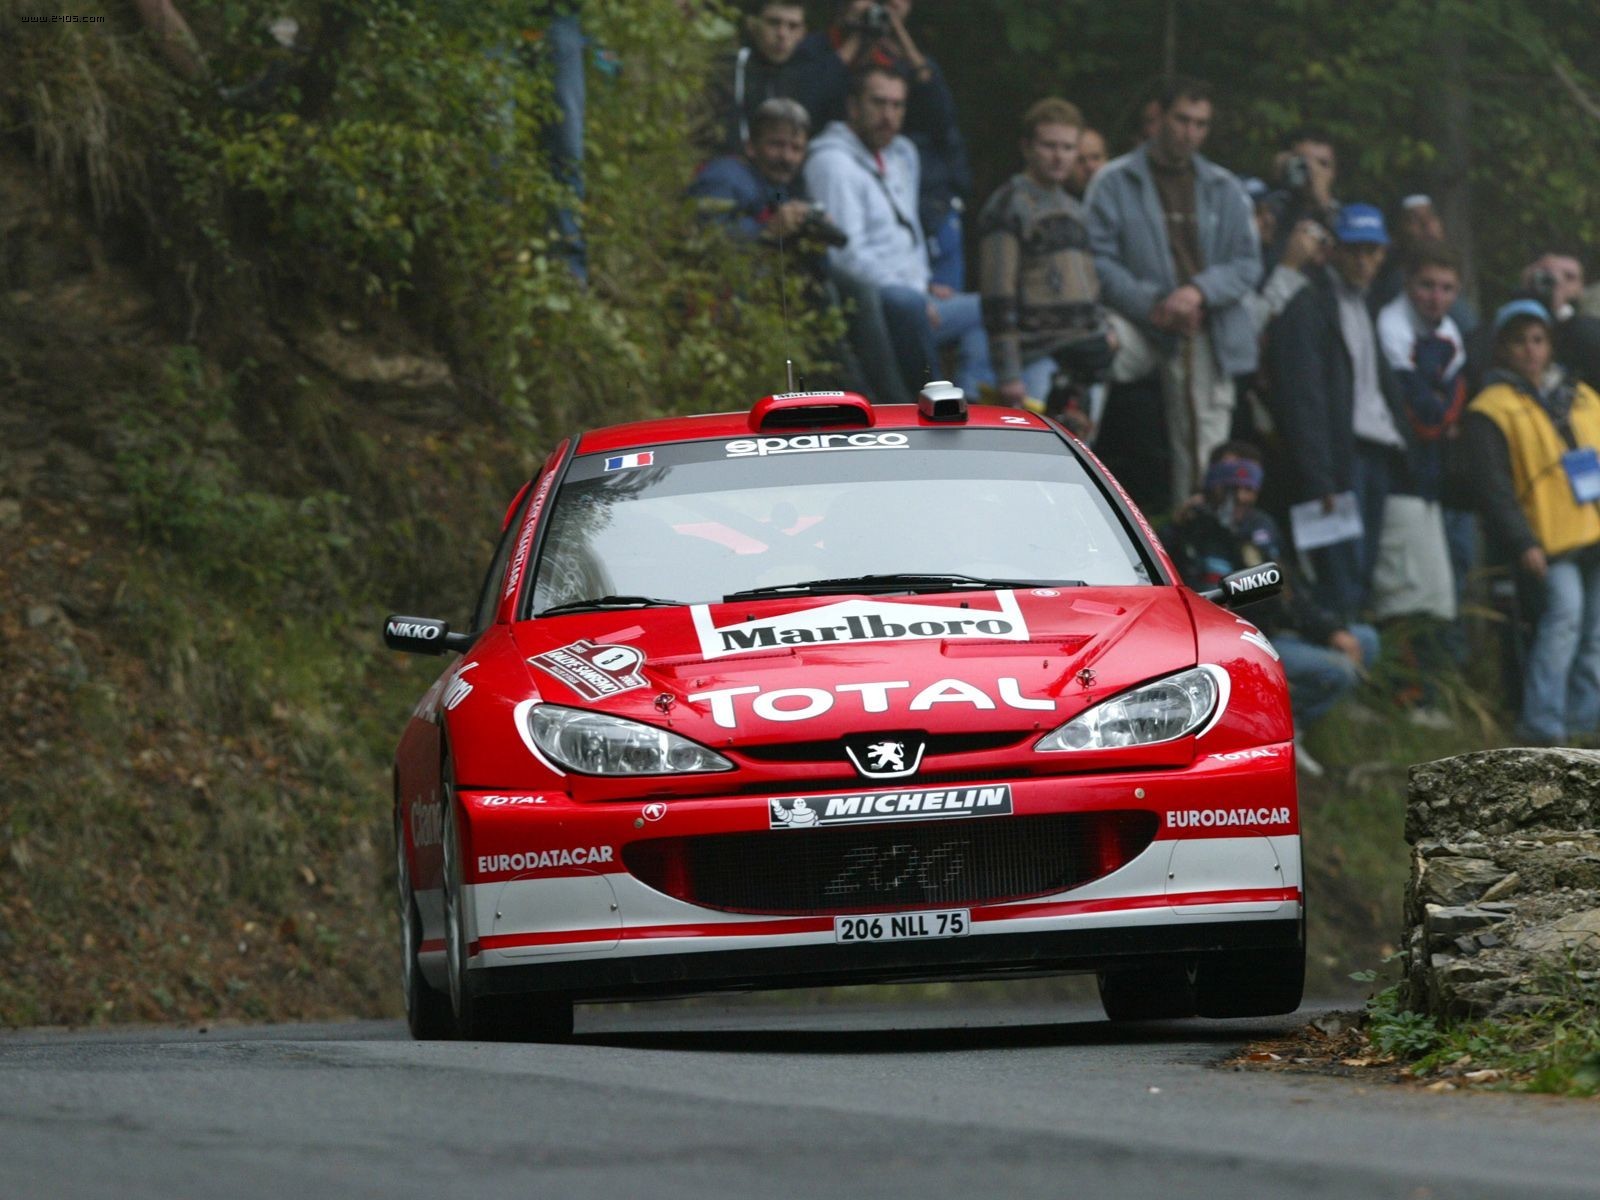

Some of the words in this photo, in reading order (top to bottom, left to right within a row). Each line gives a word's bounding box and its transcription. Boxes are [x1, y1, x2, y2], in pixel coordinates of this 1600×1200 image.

[725, 432, 909, 456] sparco
[1230, 569, 1280, 595] NIKKO
[386, 621, 440, 640] NIKKO
[717, 614, 1013, 651] Marlboro
[687, 677, 1056, 728] TOTAL
[1208, 749, 1279, 761] TOTAL
[479, 795, 548, 806] TOTAL
[824, 788, 1005, 816] MICHELIN
[1166, 807, 1290, 828] EURODATACAR
[478, 845, 613, 873] EURODATACAR
[841, 919, 883, 940] 206
[891, 915, 929, 937] NLL
[936, 913, 963, 934] 75
